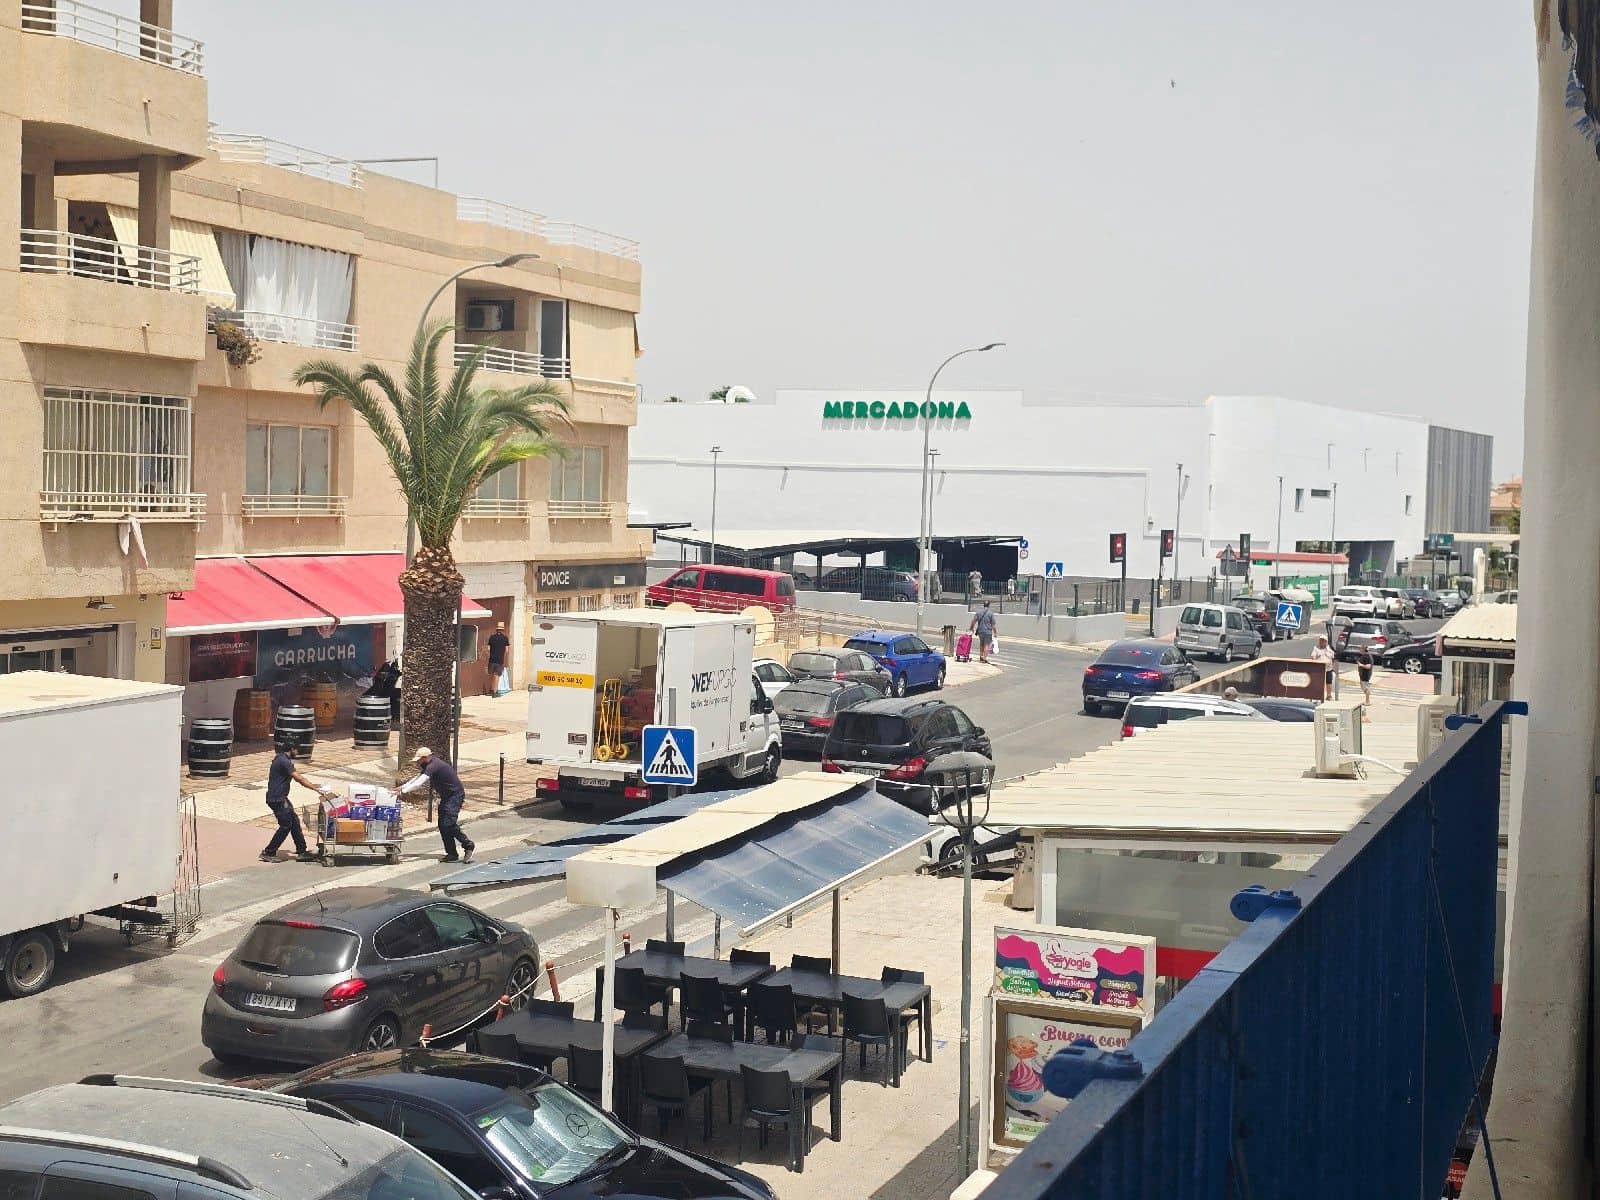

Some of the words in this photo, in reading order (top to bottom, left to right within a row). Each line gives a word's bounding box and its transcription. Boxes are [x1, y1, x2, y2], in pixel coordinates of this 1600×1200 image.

[823, 401, 972, 419] MERCADONA
[541, 571, 570, 586] PONCE
[274, 644, 356, 667] GARRUCHA
